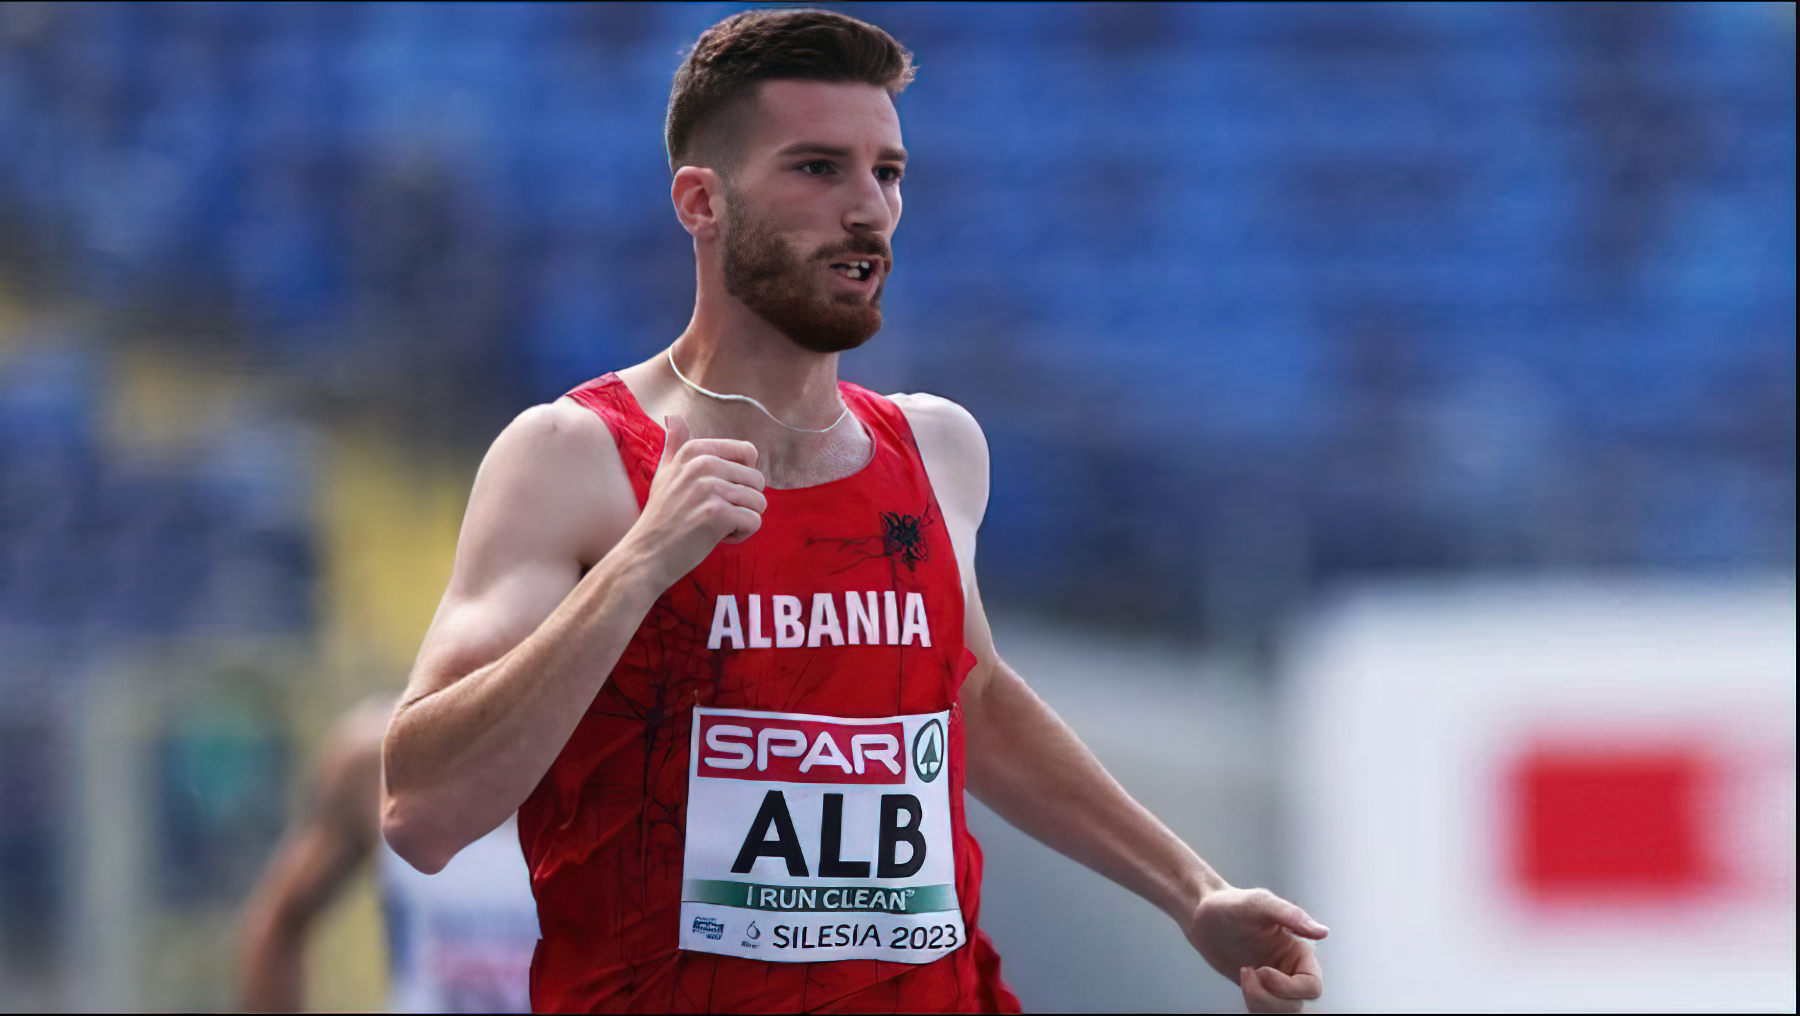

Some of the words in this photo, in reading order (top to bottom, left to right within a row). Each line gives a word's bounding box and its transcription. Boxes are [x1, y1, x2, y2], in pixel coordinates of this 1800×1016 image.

[708, 590, 932, 649] ALBANIA
[704, 724, 902, 775] SPAR
[730, 789, 927, 879] ALB
[746, 885, 753, 907] I
[759, 887, 817, 909] RUN
[822, 888, 907, 911] CLEAN
[772, 923, 881, 949] SILESIA
[889, 923, 958, 950] 2023
